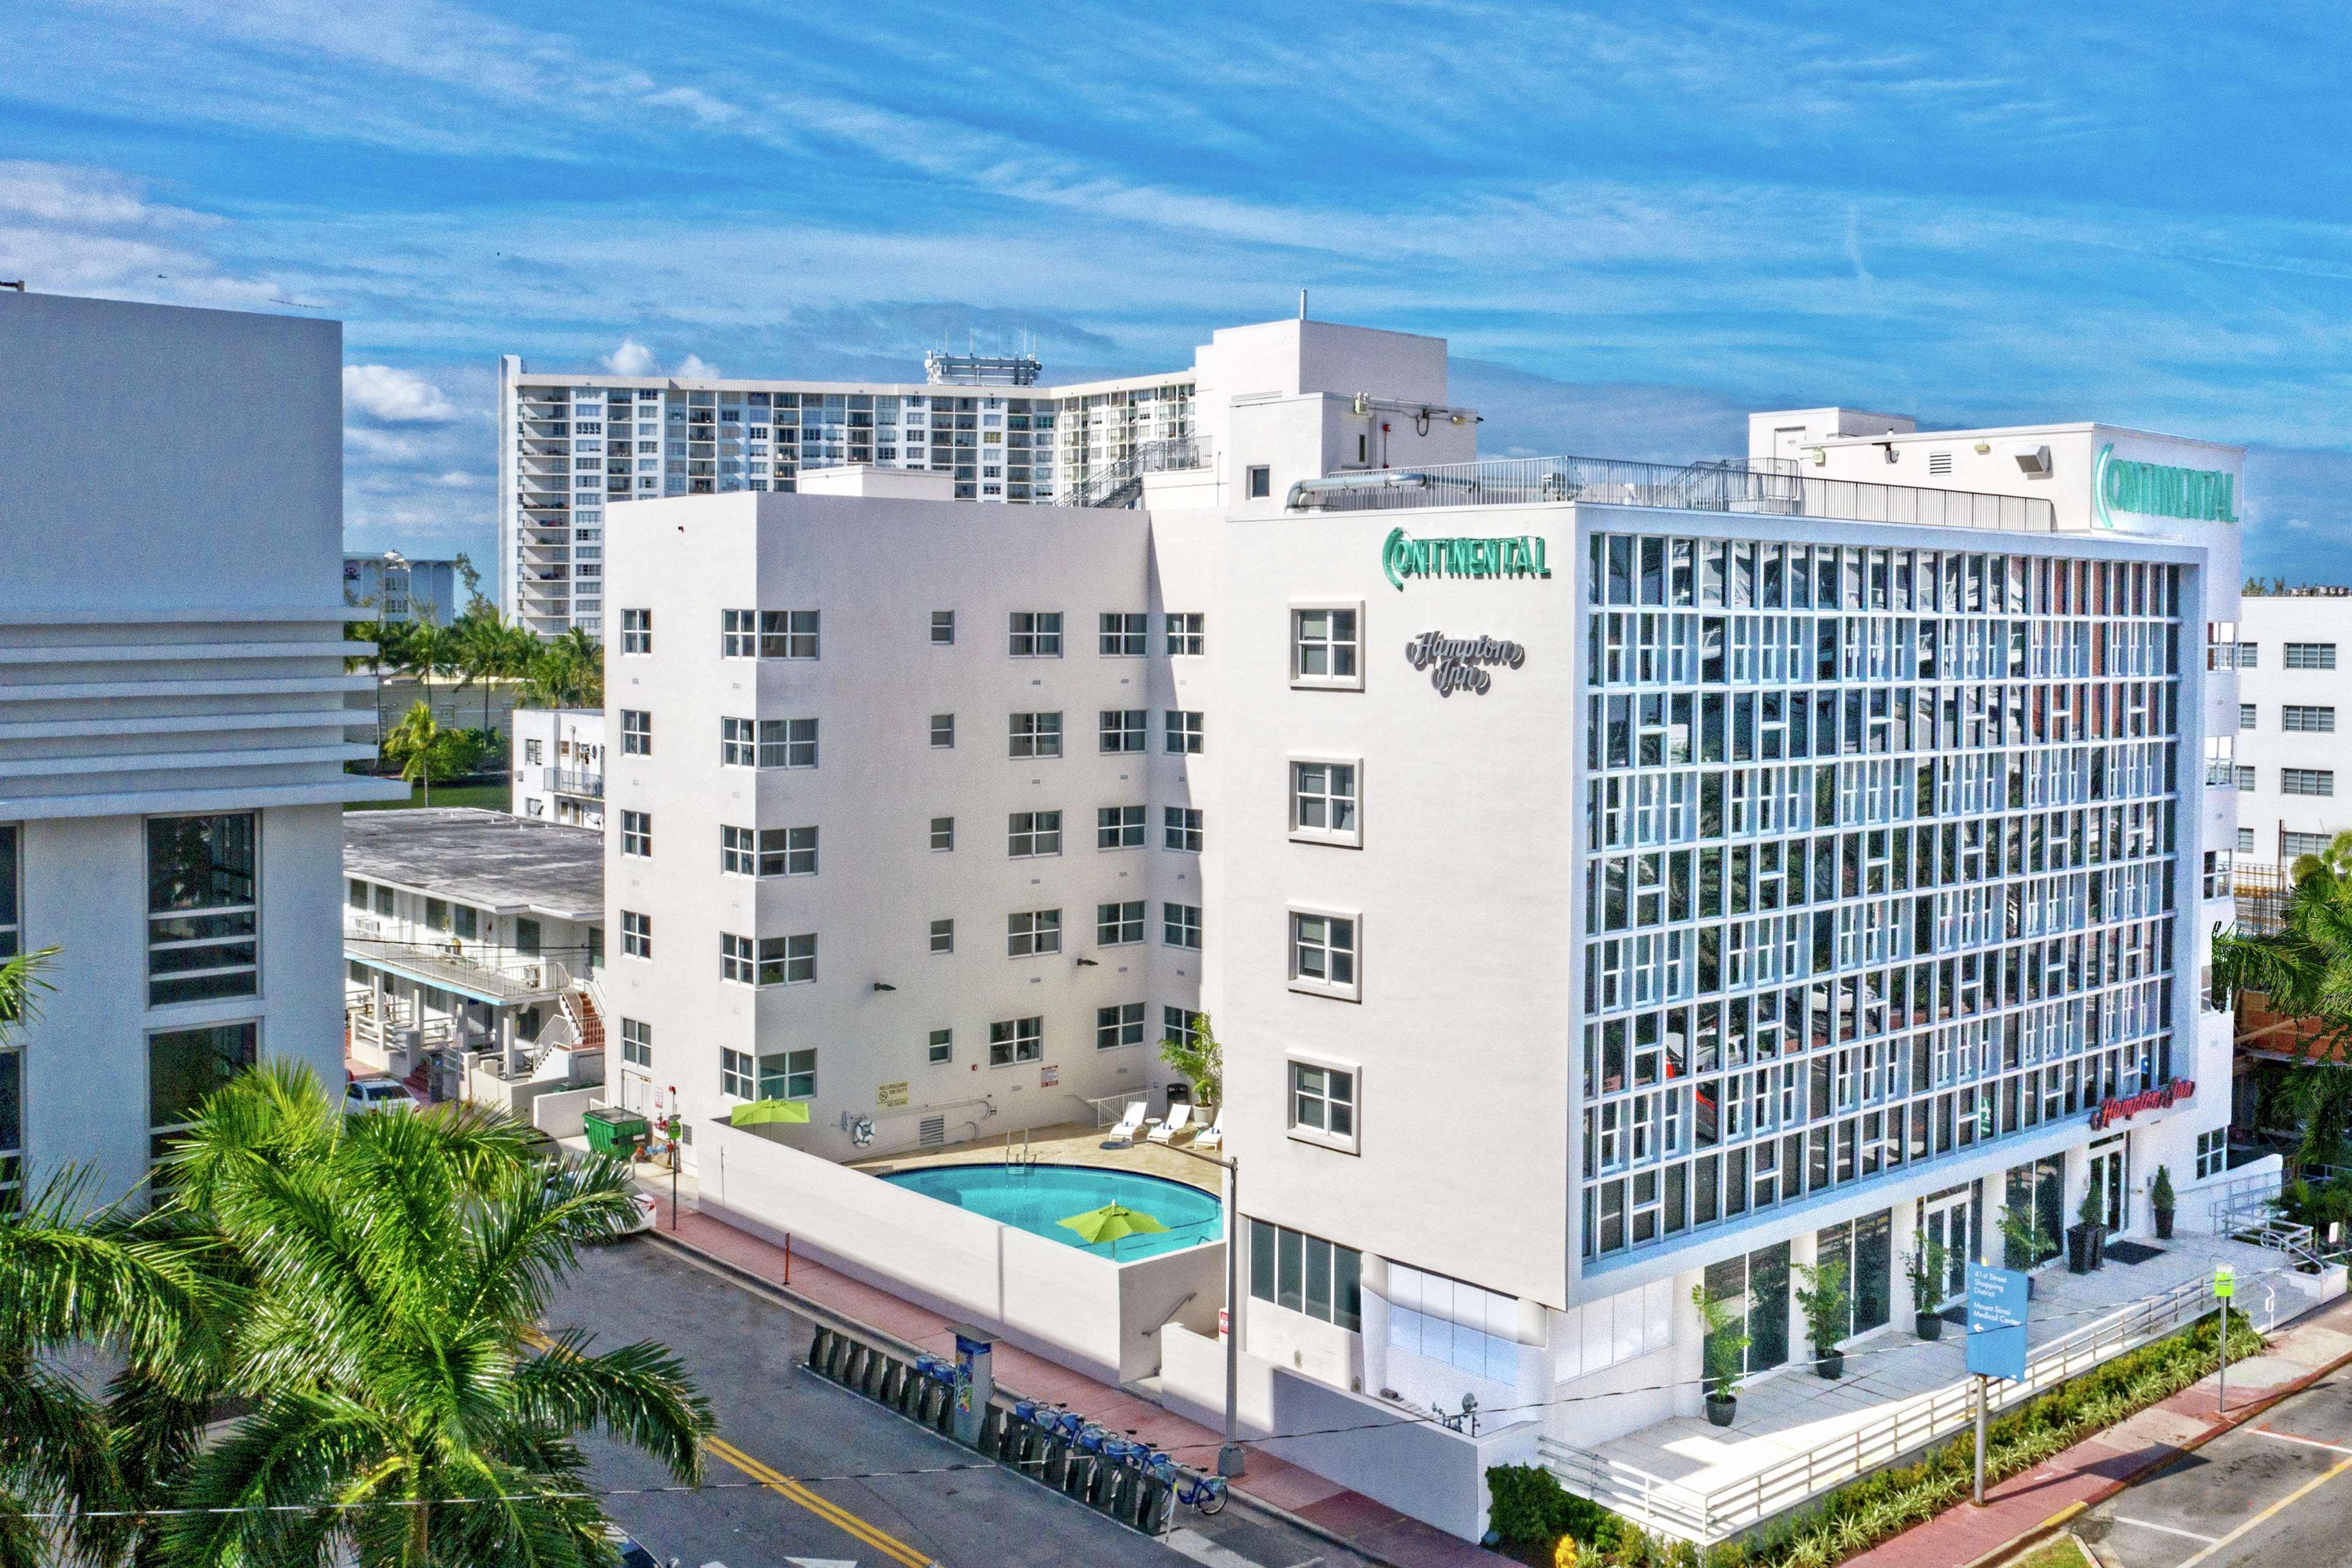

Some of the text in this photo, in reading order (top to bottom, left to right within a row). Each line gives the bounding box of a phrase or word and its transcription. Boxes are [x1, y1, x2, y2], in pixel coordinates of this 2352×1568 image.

[2095, 442, 2239, 529] CONTINENTAL
[1382, 526, 1551, 589] CONTINENTAL
[1405, 630, 1523, 666] Hampton
[1431, 658, 1490, 693] Inn
[2090, 1076, 2196, 1131] Hampton Inn
[1973, 1278, 2003, 1293] Shopping
[1989, 1272, 2007, 1283] Street
[1973, 1287, 1995, 1297] District
[1973, 1302, 2011, 1316] Mount Sinai
[1973, 1310, 2021, 1325] Medical Center
